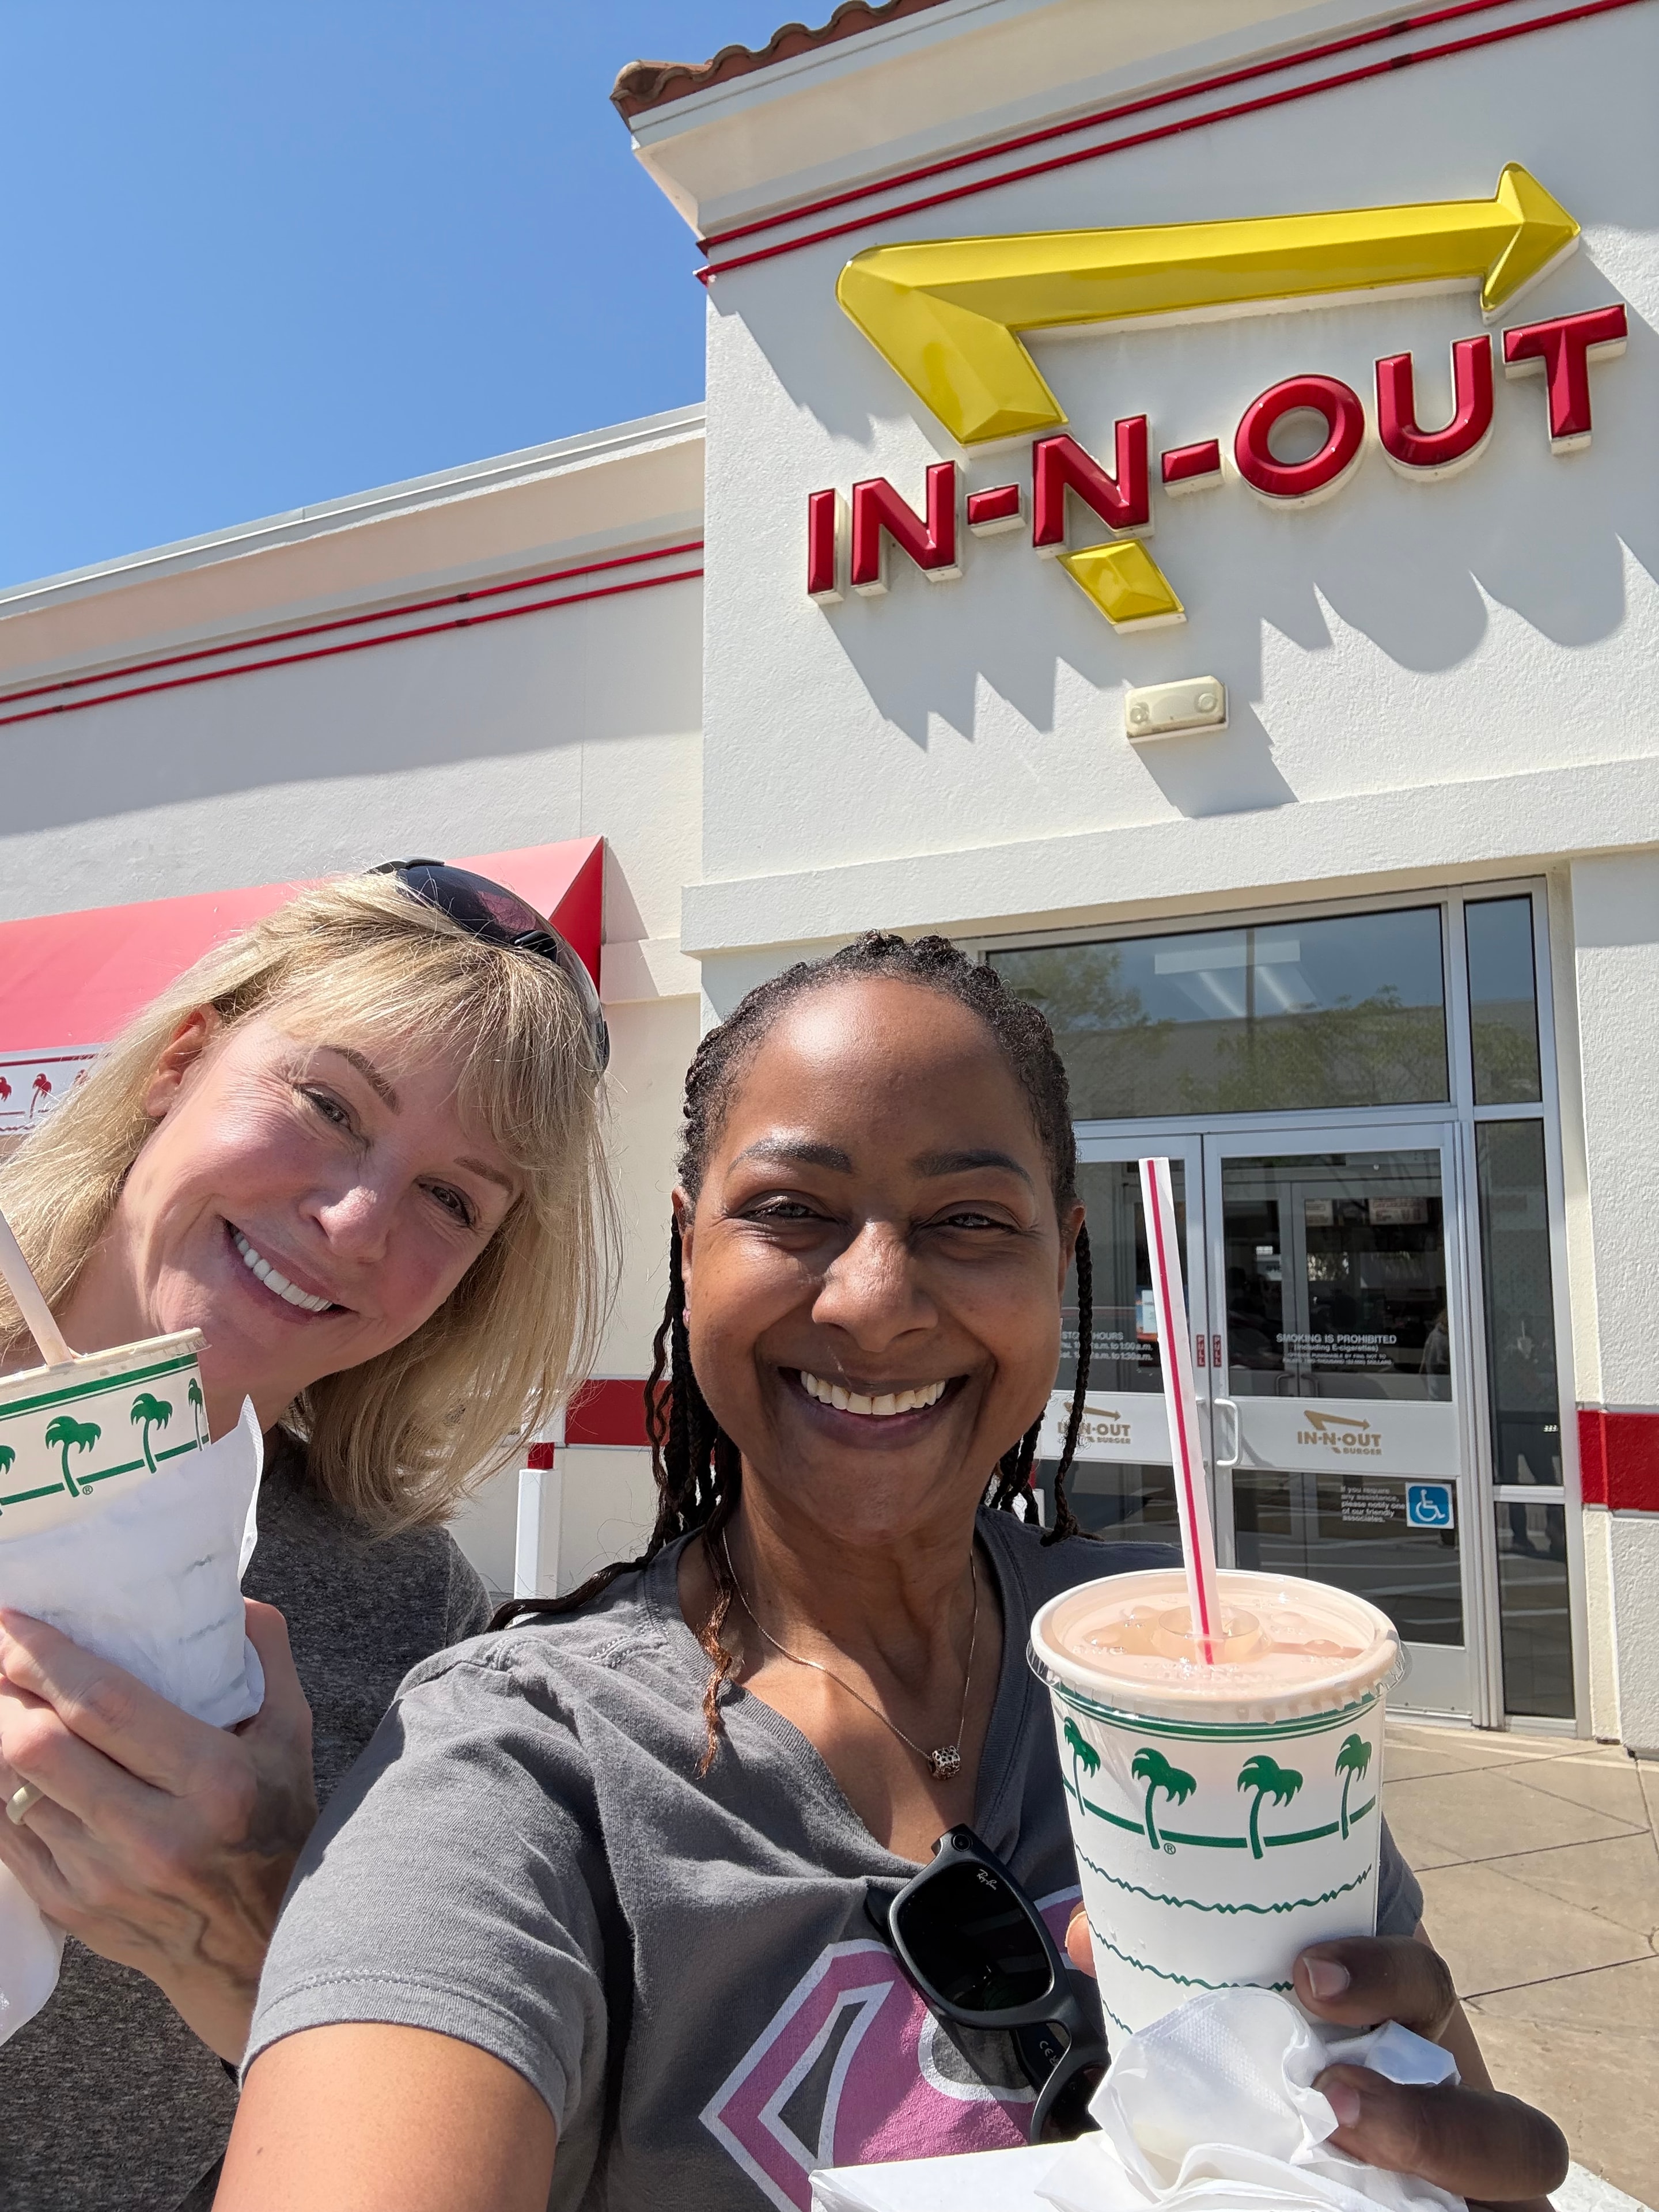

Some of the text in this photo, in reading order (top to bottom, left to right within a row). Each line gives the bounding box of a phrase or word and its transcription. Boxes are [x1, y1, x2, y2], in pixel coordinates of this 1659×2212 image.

[808, 303, 1628, 596] IN-N-OUT
[1093, 1332, 1124, 1340] HOURS
[1276, 1333, 1397, 1344] SMOKING IS PROHIBITED
[1342, 1447, 1382, 1456] BURGER
[1341, 1500, 1366, 1508] please
[1368, 1501, 1389, 1509] notify
[1366, 1508, 1395, 1518] friendly
